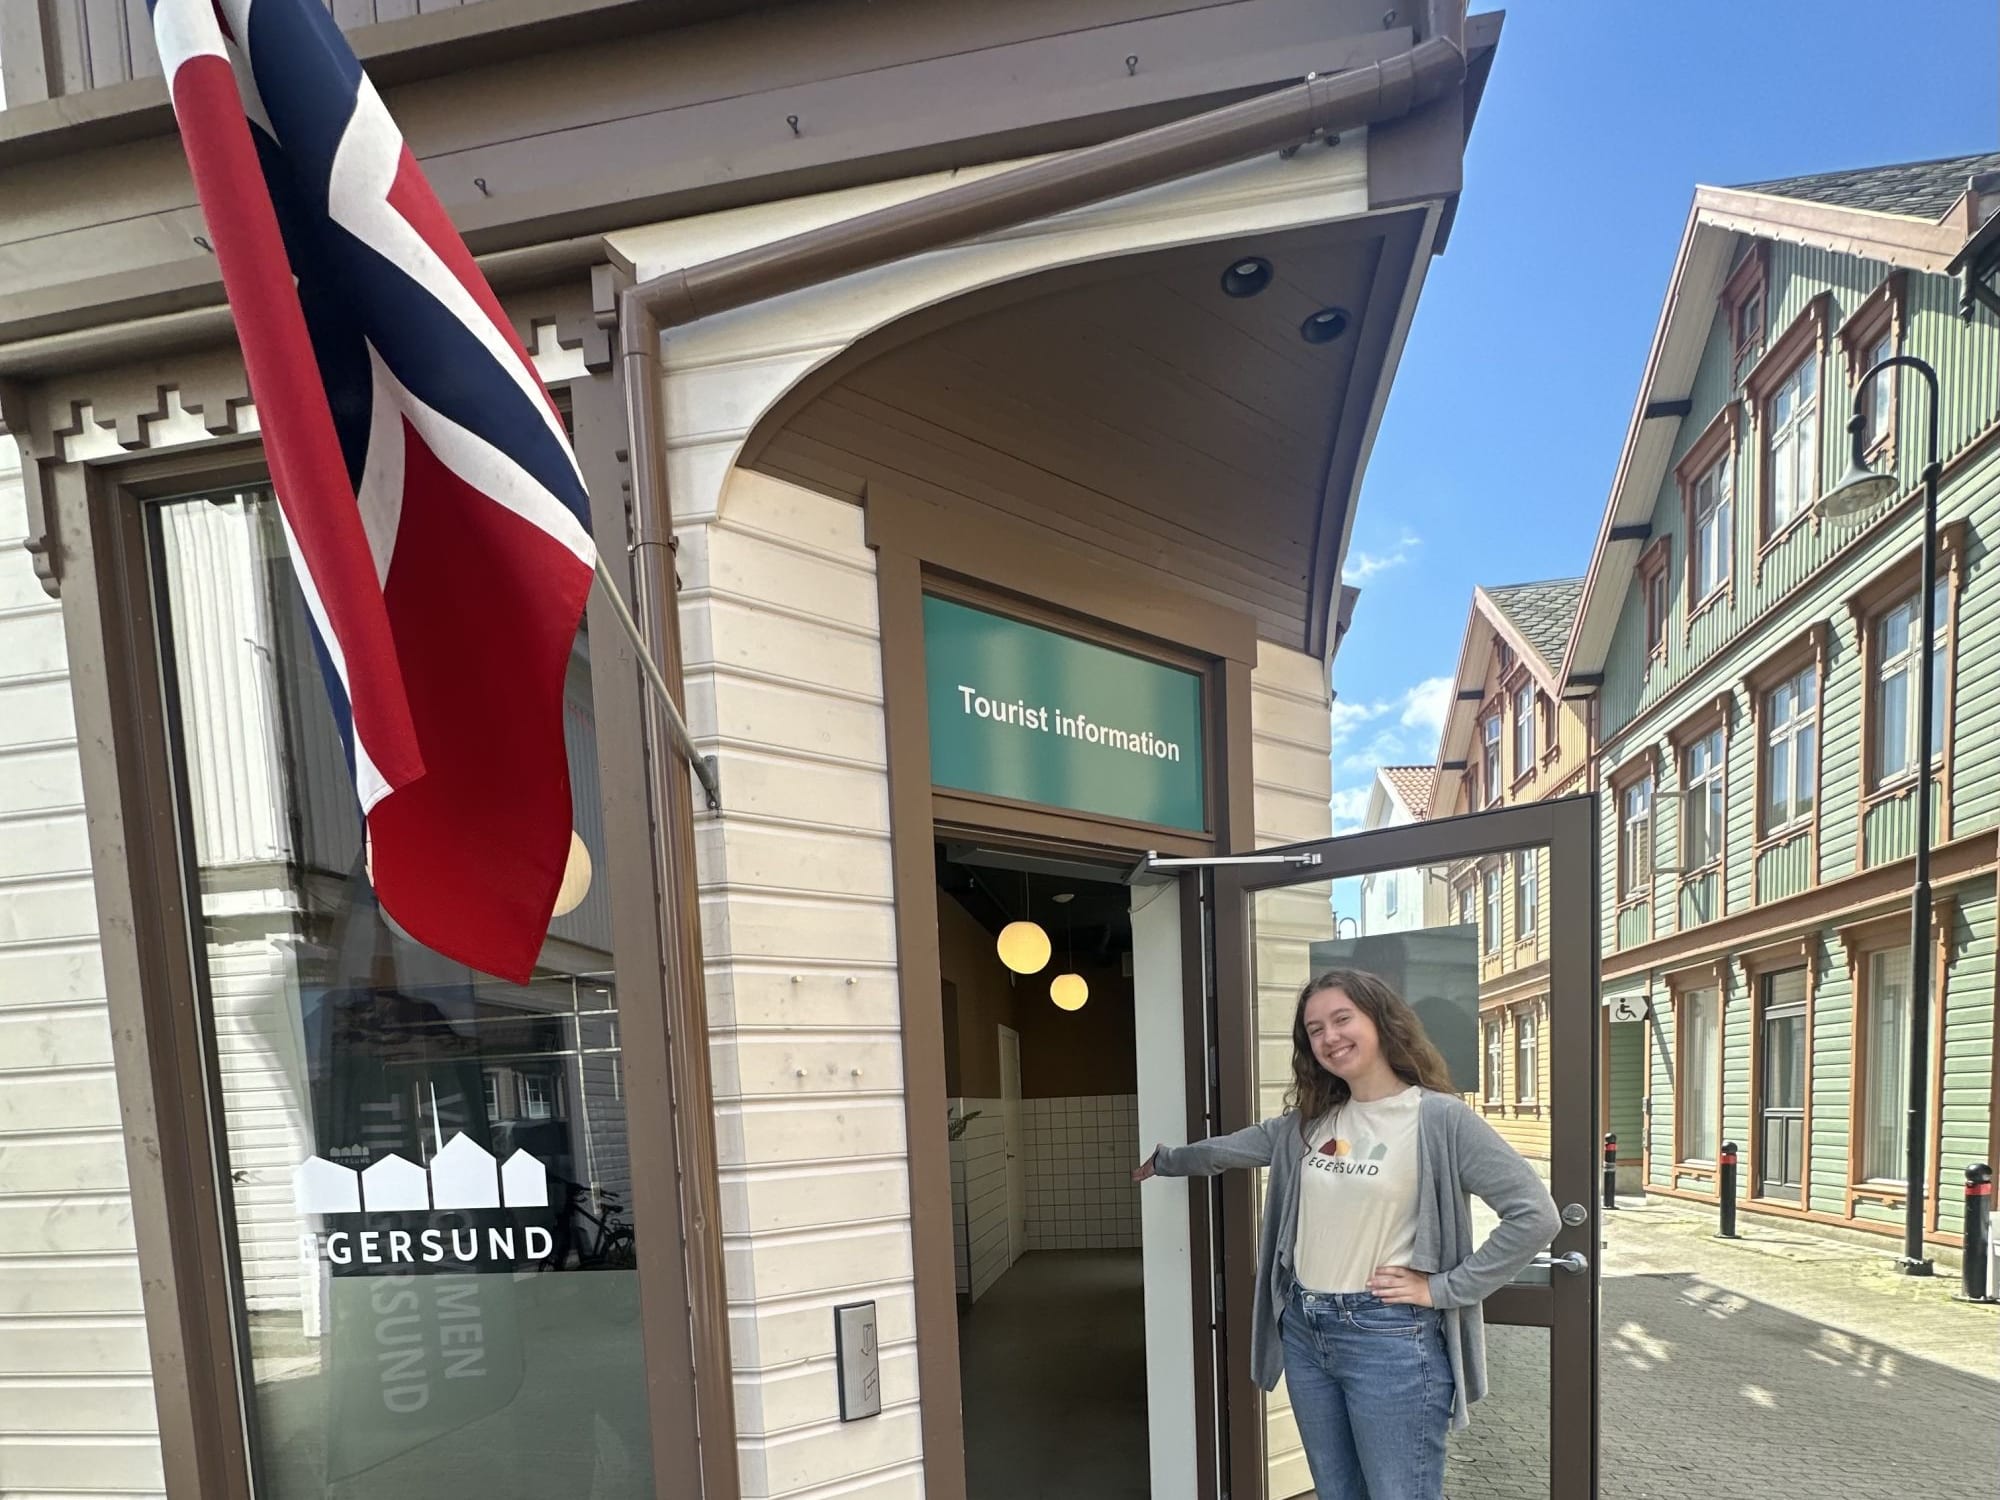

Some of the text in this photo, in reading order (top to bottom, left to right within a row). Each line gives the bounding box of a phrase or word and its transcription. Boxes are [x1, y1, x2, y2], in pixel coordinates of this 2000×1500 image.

[958, 684, 1180, 762] Tourist information
[1308, 1156, 1380, 1176] EGERSUND
